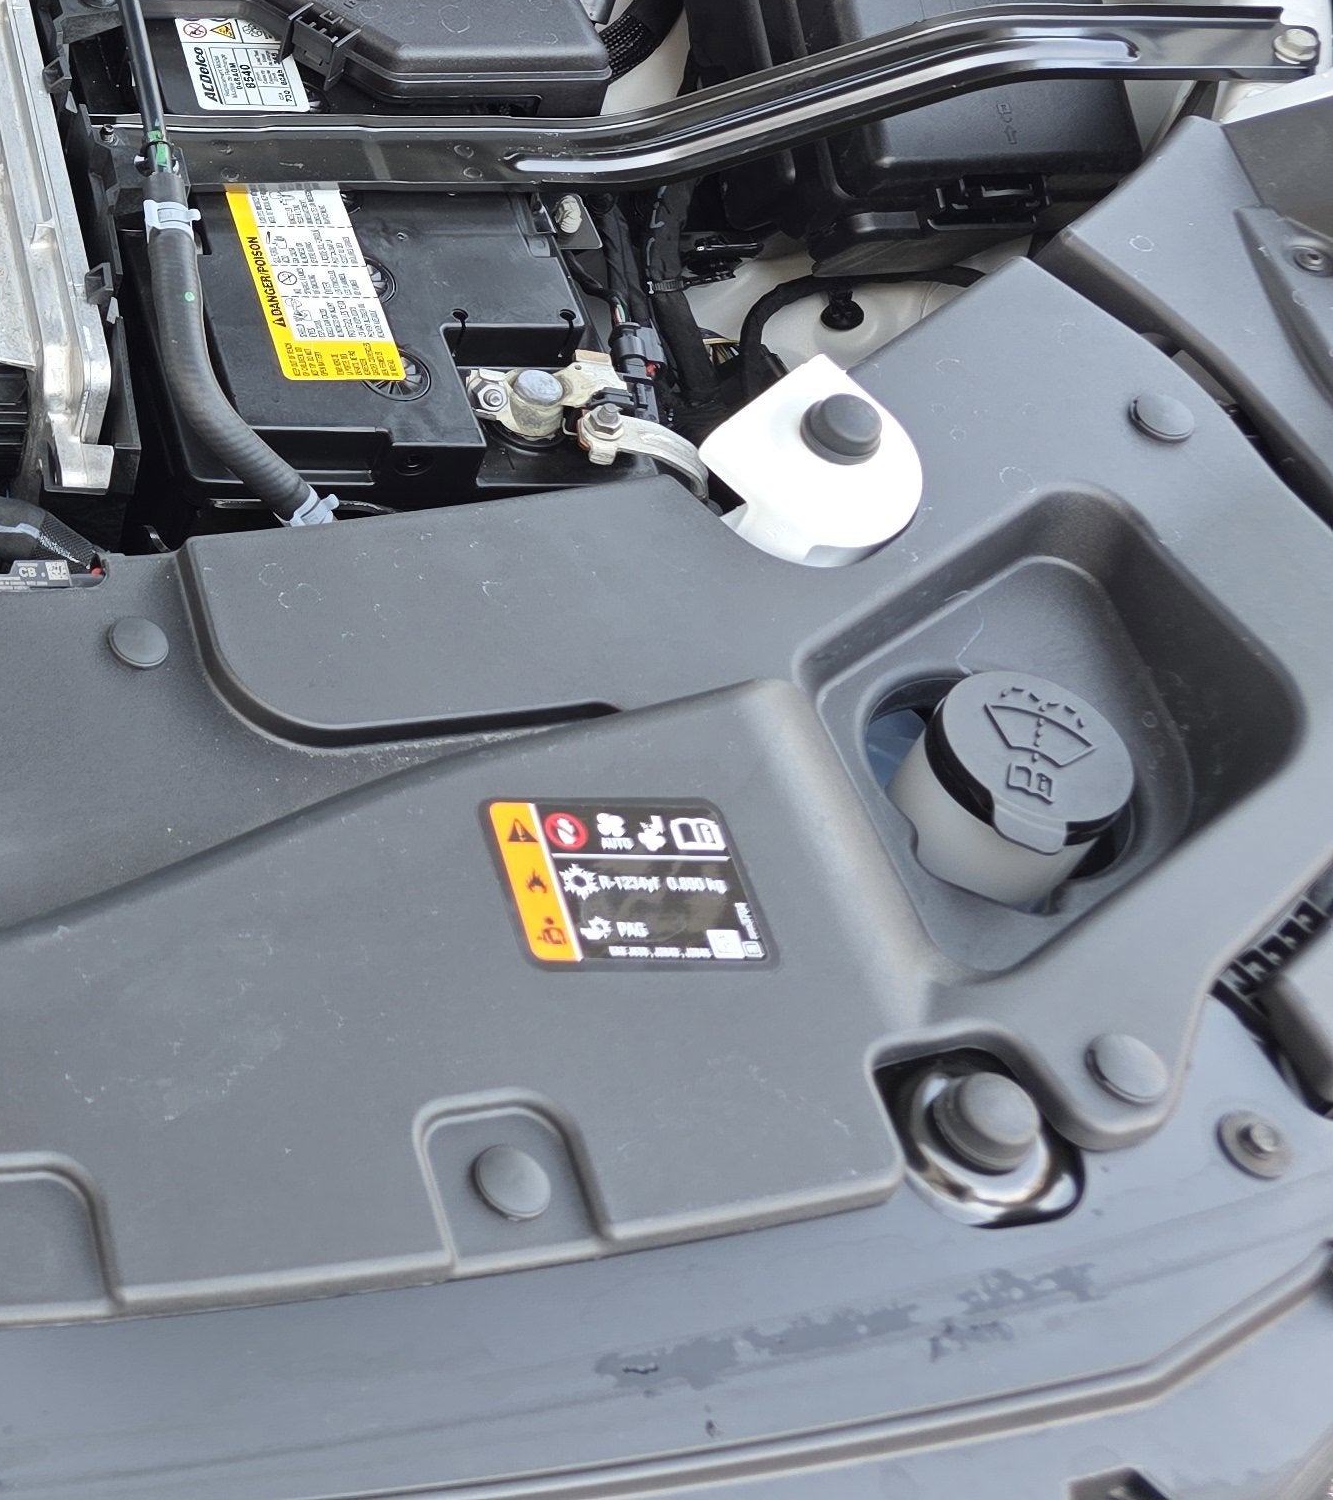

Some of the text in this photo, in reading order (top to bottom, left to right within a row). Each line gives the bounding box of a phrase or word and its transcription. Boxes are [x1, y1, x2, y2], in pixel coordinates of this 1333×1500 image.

[194, 47, 218, 102] ACDelco
[246, 236, 281, 316] DANGER/POISON
[18, 567, 37, 578] CB
[616, 921, 650, 939] PAG
